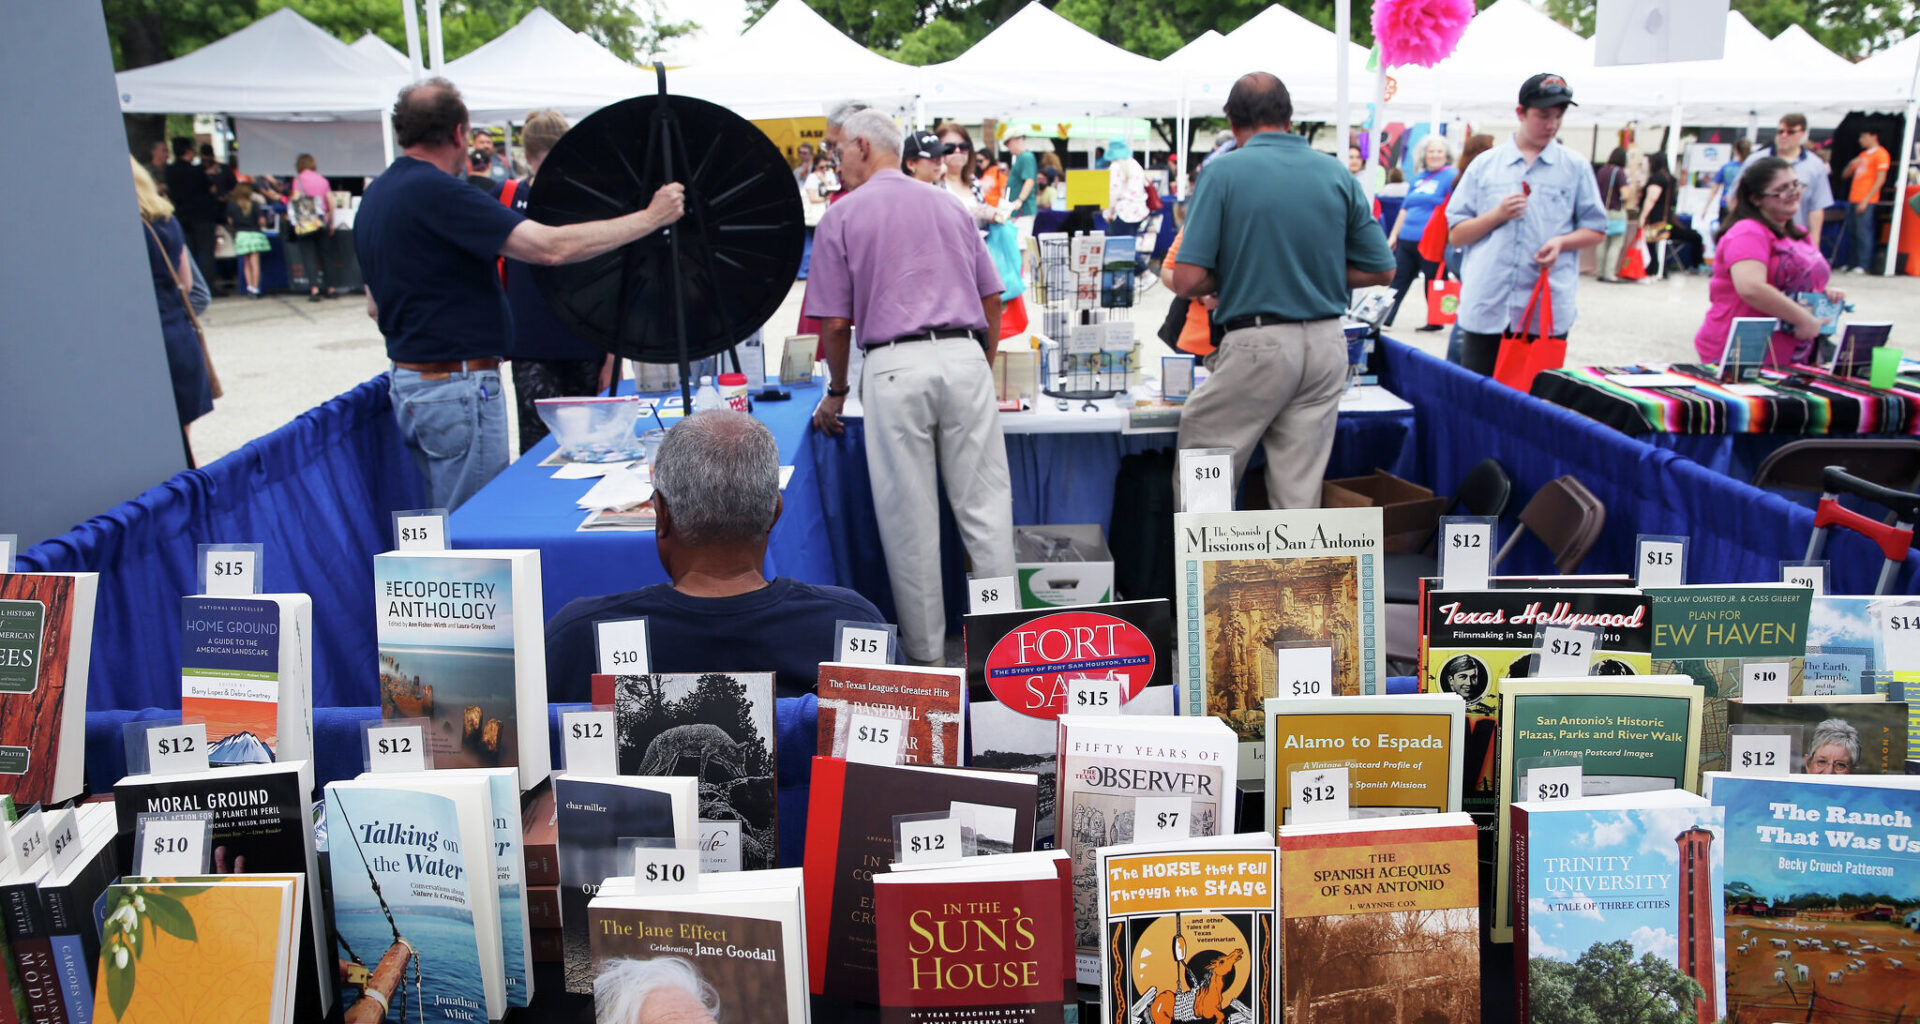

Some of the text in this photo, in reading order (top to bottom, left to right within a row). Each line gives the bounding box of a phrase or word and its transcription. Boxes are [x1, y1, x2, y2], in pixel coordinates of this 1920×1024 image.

[1195, 466, 1220, 480] $10
[402, 528, 427, 542] $15
[1185, 524, 1375, 554] Missions of San Antonio
[1213, 526, 1261, 538] The Spanish
[1452, 534, 1480, 548] $12
[1647, 552, 1673, 566] $15
[214, 562, 243, 576] $15
[394, 581, 496, 600] ECOPOETRY
[981, 589, 998, 604] $8
[1692, 595, 1726, 603] OLMSTED
[388, 601, 496, 620] ANTHOLOGY
[1439, 602, 1646, 629] Texas Hollywood
[1689, 610, 1741, 620] PLAN FOR
[186, 620, 278, 634] HOME GROUND
[1453, 631, 1504, 640] Filmmaking
[1706, 623, 1796, 645] HAVEN
[850, 637, 878, 653] $15
[1014, 624, 1126, 664] FORT
[1551, 639, 1582, 656] $12
[613, 650, 638, 666] $10
[1804, 662, 1820, 670] The
[1754, 671, 1776, 682] $10
[230, 689, 246, 697] Debra
[829, 679, 950, 698] The Texas Greatest Hits
[1292, 681, 1320, 696] $10
[1077, 690, 1108, 706] $15
[1536, 716, 1664, 728] San Antonio's Historic
[572, 722, 603, 740] $12
[858, 726, 889, 744] $15
[1519, 730, 1682, 742] Plazas, Parks and River Walk
[158, 736, 194, 755] $12
[378, 738, 412, 754] $12
[1075, 742, 1220, 761] FIFTY YEARS OF
[1284, 734, 1443, 752] Alamo to Espada
[1586, 749, 1620, 757] Postcard
[1624, 750, 1654, 758] Images
[1742, 751, 1776, 767] $12
[1383, 762, 1410, 770] Profile
[1412, 762, 1424, 770] of
[1086, 766, 1214, 796] OBSERVER
[1356, 781, 1427, 790] Spanish Missions
[1302, 785, 1335, 804] $12
[1538, 783, 1569, 801] $20
[148, 789, 268, 813] MORAL GROUND
[566, 802, 607, 812] char miller
[222, 809, 248, 818] PLANET
[250, 808, 258, 816] IN
[260, 806, 280, 815] PERIL
[1157, 812, 1178, 829] $7
[1769, 802, 1912, 828] The Ranch
[54, 828, 72, 855] $14
[154, 836, 188, 855] $10
[360, 820, 459, 854] Talking on
[911, 834, 945, 854] $12
[1756, 826, 1881, 850] That Was
[373, 853, 464, 880] the Water
[1368, 853, 1396, 864] THE
[1544, 856, 1633, 873] TRINITY
[1778, 856, 1894, 876] Becky Crouch Patterson
[646, 862, 686, 882] $10
[1110, 862, 1267, 881] The HORSE that Fell
[1314, 864, 1450, 882] SPANISH ACEQUIAS
[1321, 879, 1444, 897] OF SAN ANTONIO
[1544, 874, 1672, 892] UNIVERSITY
[410, 890, 432, 898] Nature
[1110, 885, 1198, 902] Through the
[944, 902, 1000, 914] IN THE
[1357, 901, 1394, 910] WAYNNE
[1547, 900, 1670, 912] A TALE OF THREE CITIES
[600, 920, 728, 942] The Jane Effect
[908, 907, 1036, 955] SUN'S
[650, 942, 776, 962] Celebrating Jane Goodall
[909, 957, 1040, 991] HOUSE
[434, 994, 478, 1009] Jonathan
[444, 1008, 474, 1022] White
